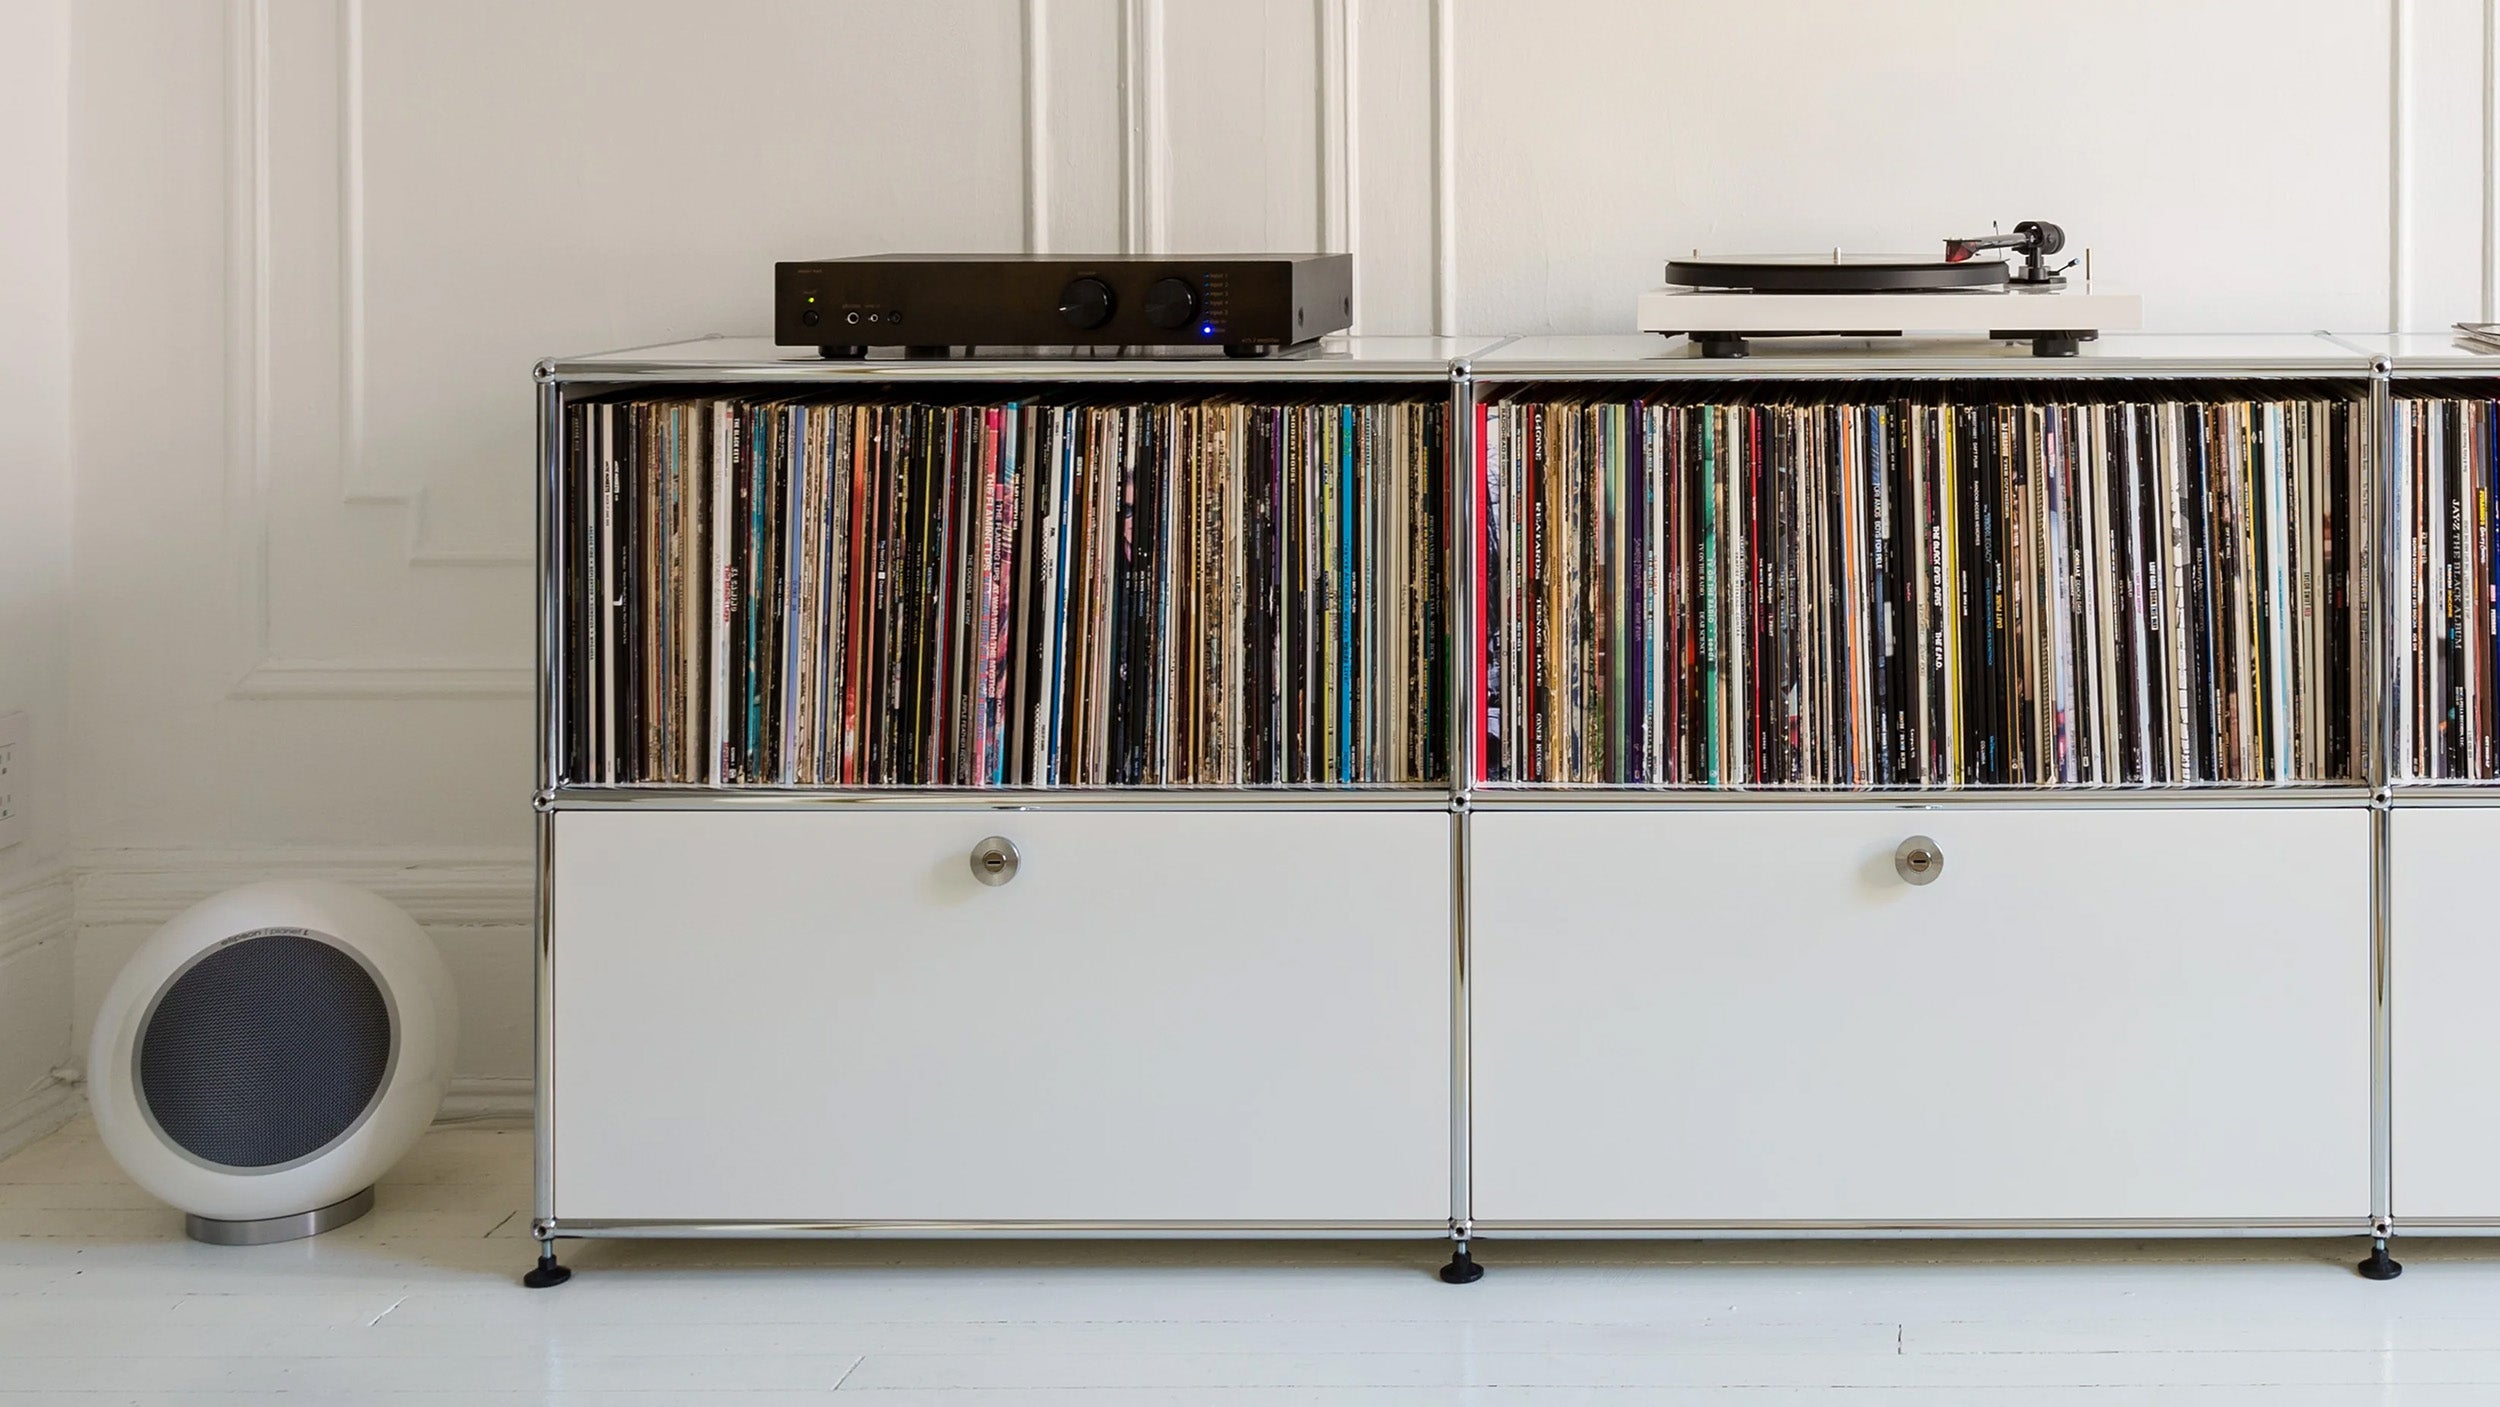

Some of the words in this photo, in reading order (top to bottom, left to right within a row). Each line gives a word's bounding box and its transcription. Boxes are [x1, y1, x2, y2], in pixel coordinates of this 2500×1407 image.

[986, 472, 995, 494] THE
[984, 496, 994, 544] FLAMING
[995, 504, 1003, 520] THE
[1873, 498, 1881, 518] AMOS
[2452, 499, 2460, 531] JAY-Z
[994, 522, 1002, 560] FLAMING
[1874, 520, 1882, 538] BOYS
[2453, 533, 2461, 559] THE
[983, 547, 992, 571] LIPS
[1933, 566, 1941, 585] EYED
[2453, 561, 2461, 602] BLACK
[991, 598, 999, 616] WAR
[2454, 605, 2462, 649] ALBUM
[988, 660, 997, 698] MYSTICS
